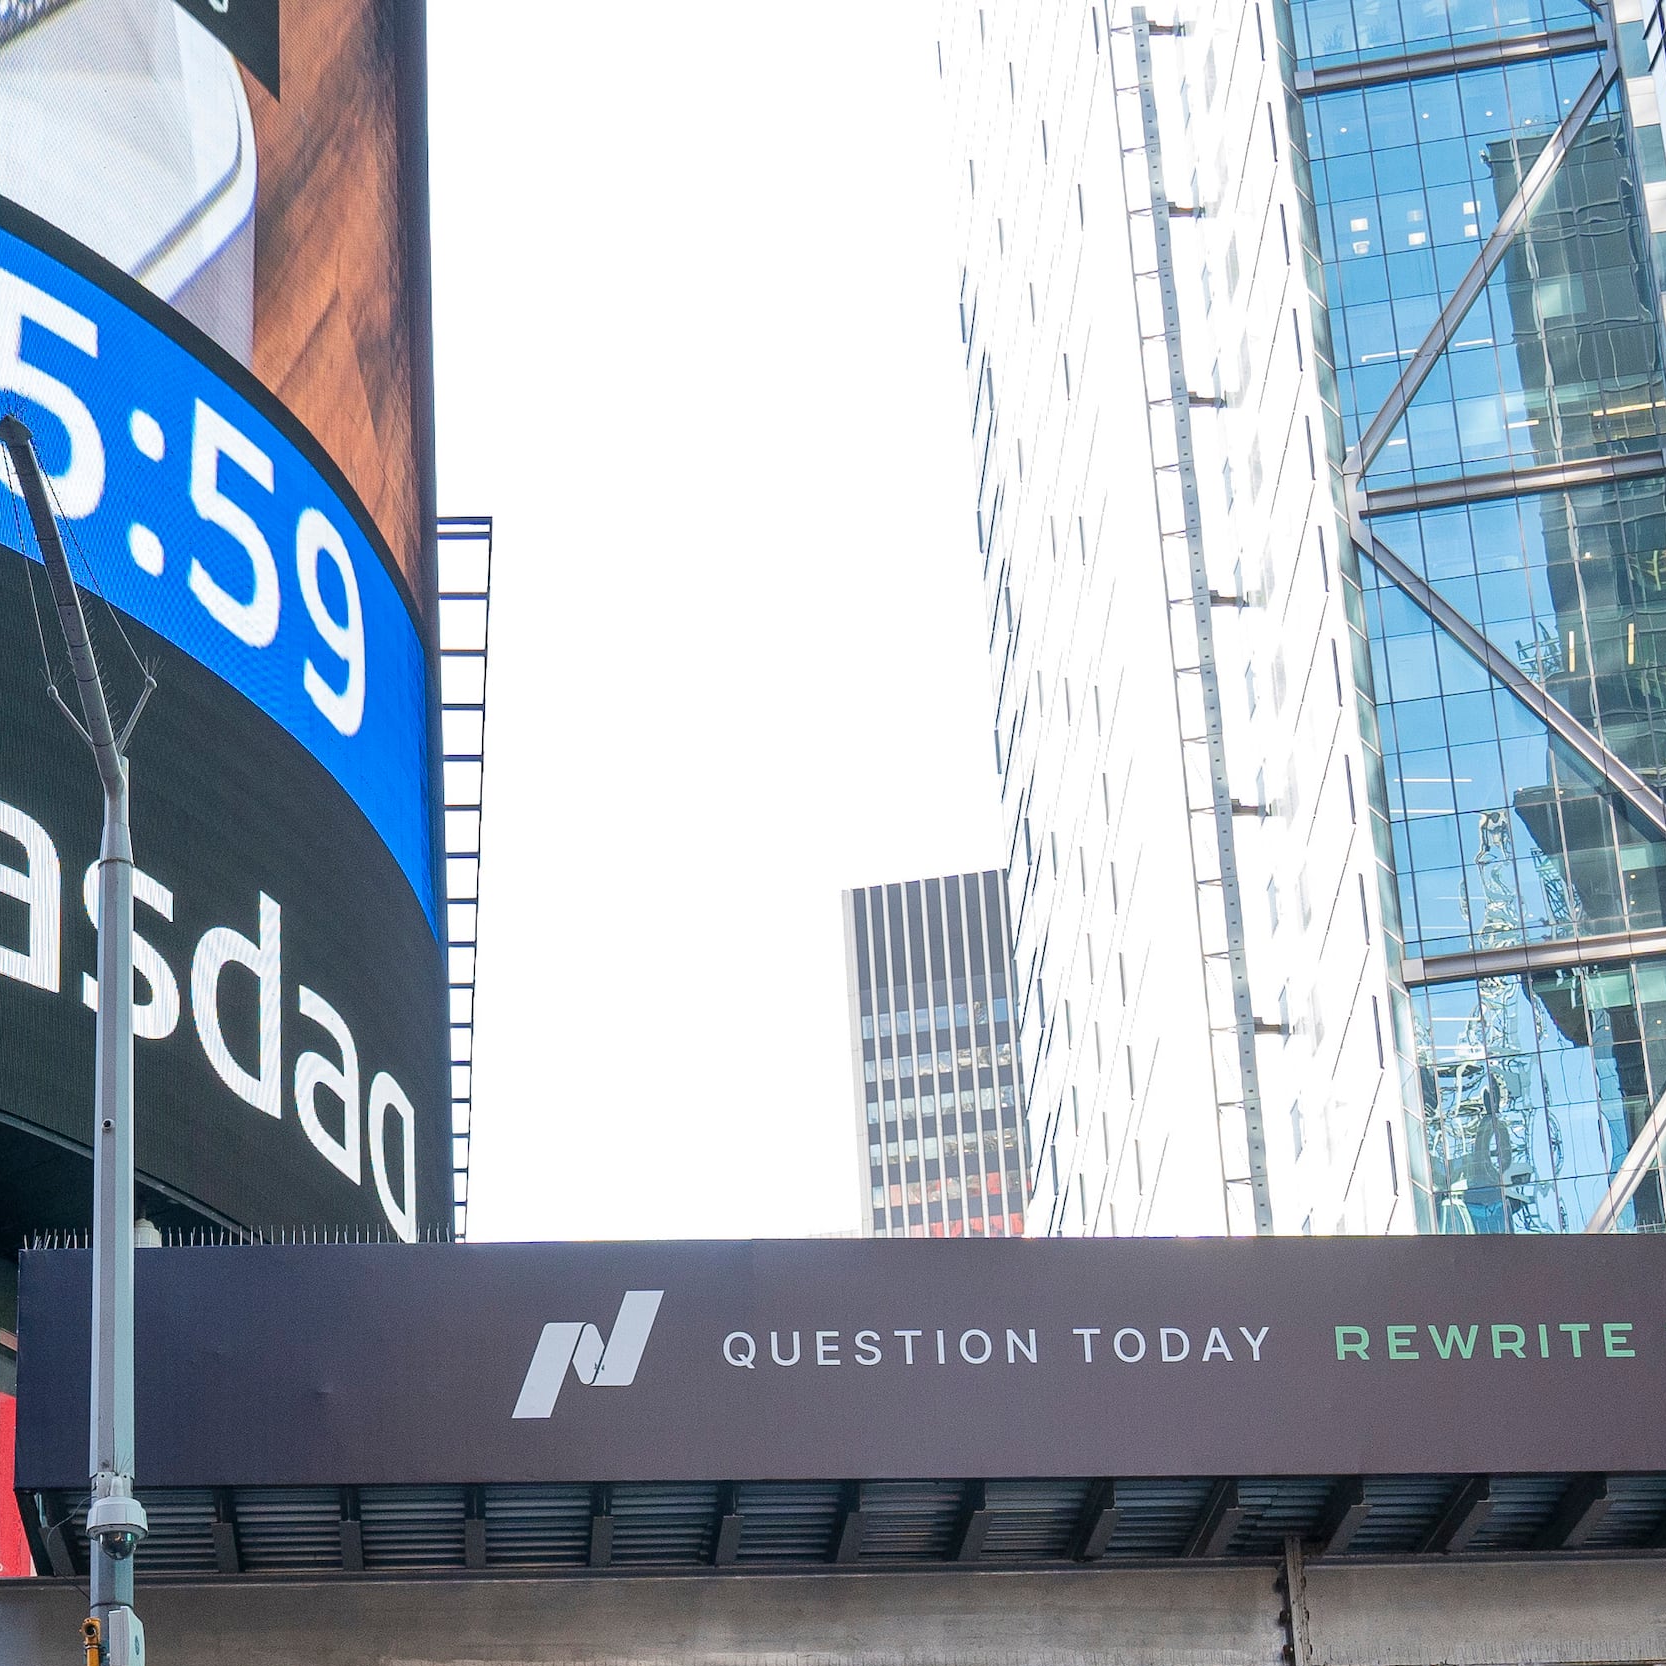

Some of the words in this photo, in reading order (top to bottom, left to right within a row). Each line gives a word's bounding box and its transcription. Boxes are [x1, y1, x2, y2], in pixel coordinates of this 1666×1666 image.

[723, 1328, 1039, 1370] QUESTION
[1073, 1325, 1272, 1365] TODAY
[1335, 1322, 1636, 1361] REWRITE
